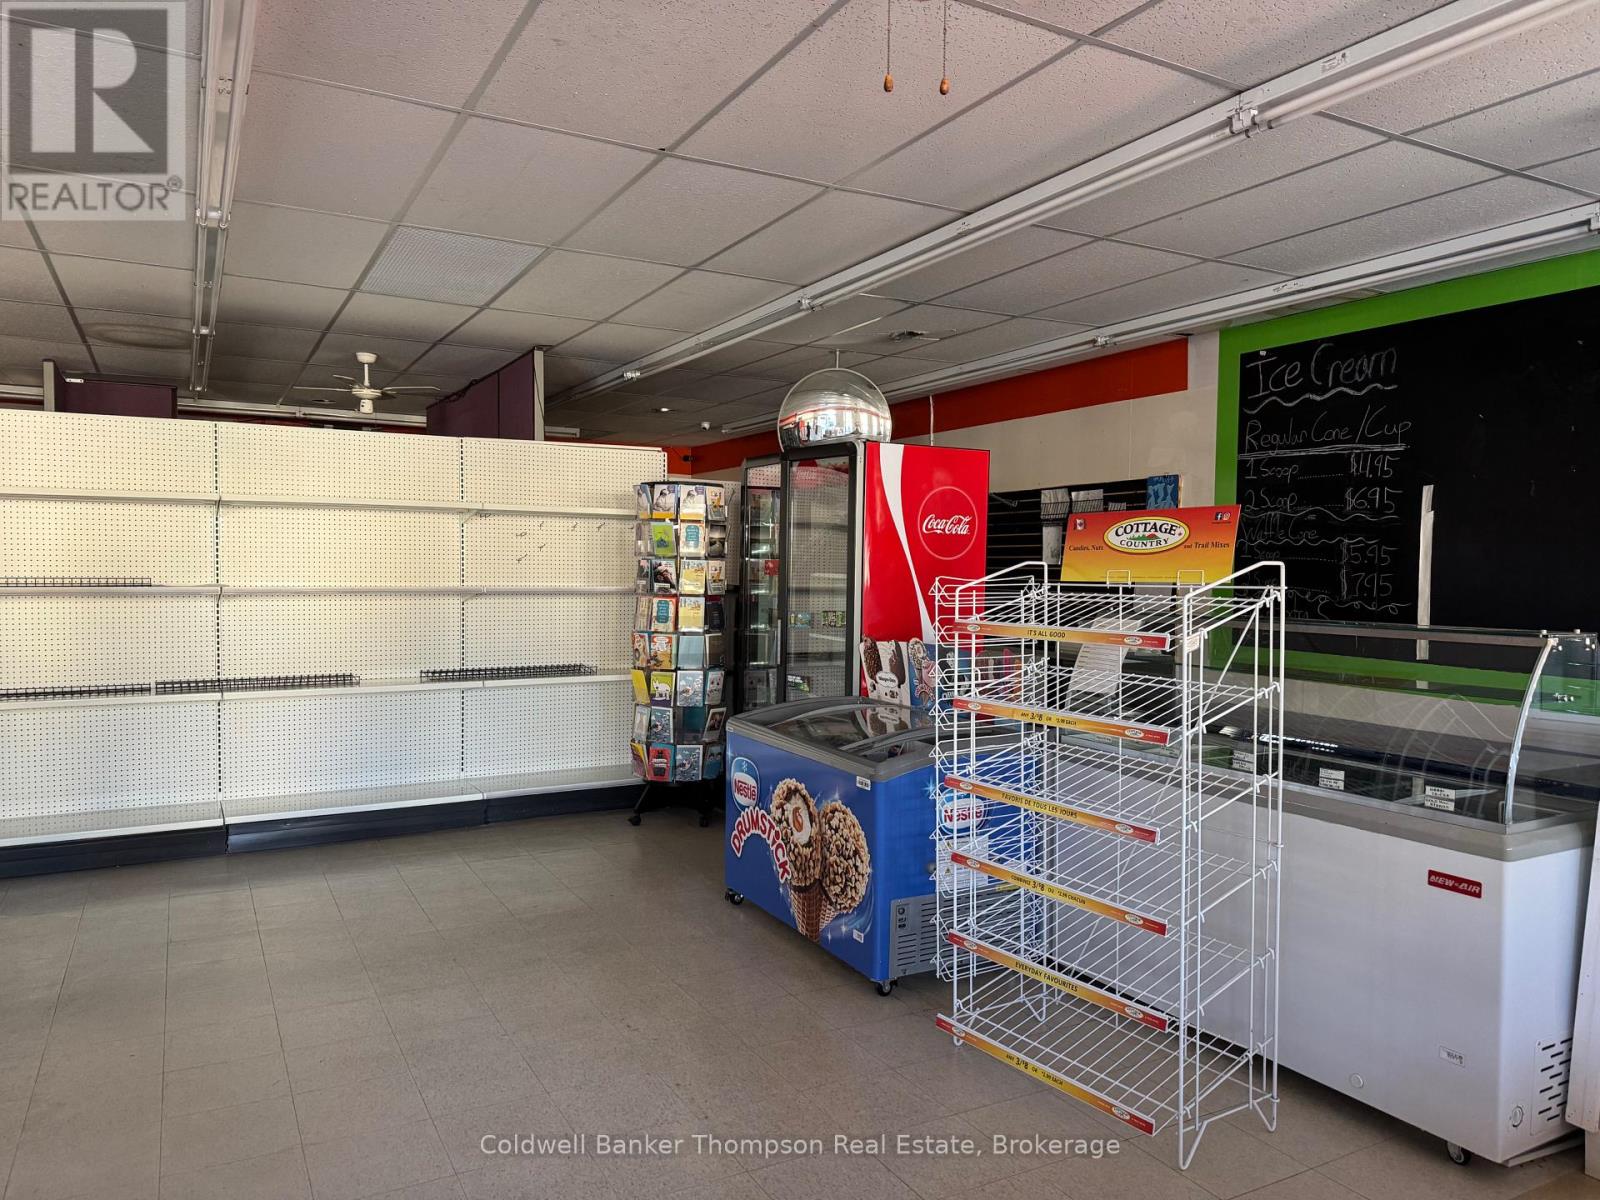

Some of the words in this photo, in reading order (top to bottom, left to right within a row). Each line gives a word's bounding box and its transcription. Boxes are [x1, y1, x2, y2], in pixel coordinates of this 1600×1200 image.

[1246, 357, 1303, 399] Ice
[1311, 343, 1397, 388] Cream
[1345, 486, 1403, 514] $6.95
[922, 513, 973, 535] Coca-Cola
[1114, 521, 1177, 538] COTTAGE
[1119, 537, 1170, 549] COUNTRY
[1194, 541, 1210, 549] Trail
[1038, 630, 1048, 638] ALL
[1049, 631, 1066, 639] GOOD
[1001, 792, 1023, 804] FAVORIS
[1024, 798, 1031, 806] DE
[1048, 804, 1058, 814] LES
[1015, 961, 1043, 977] EVERYDAY
[1043, 972, 1078, 992] FAVOURITES
